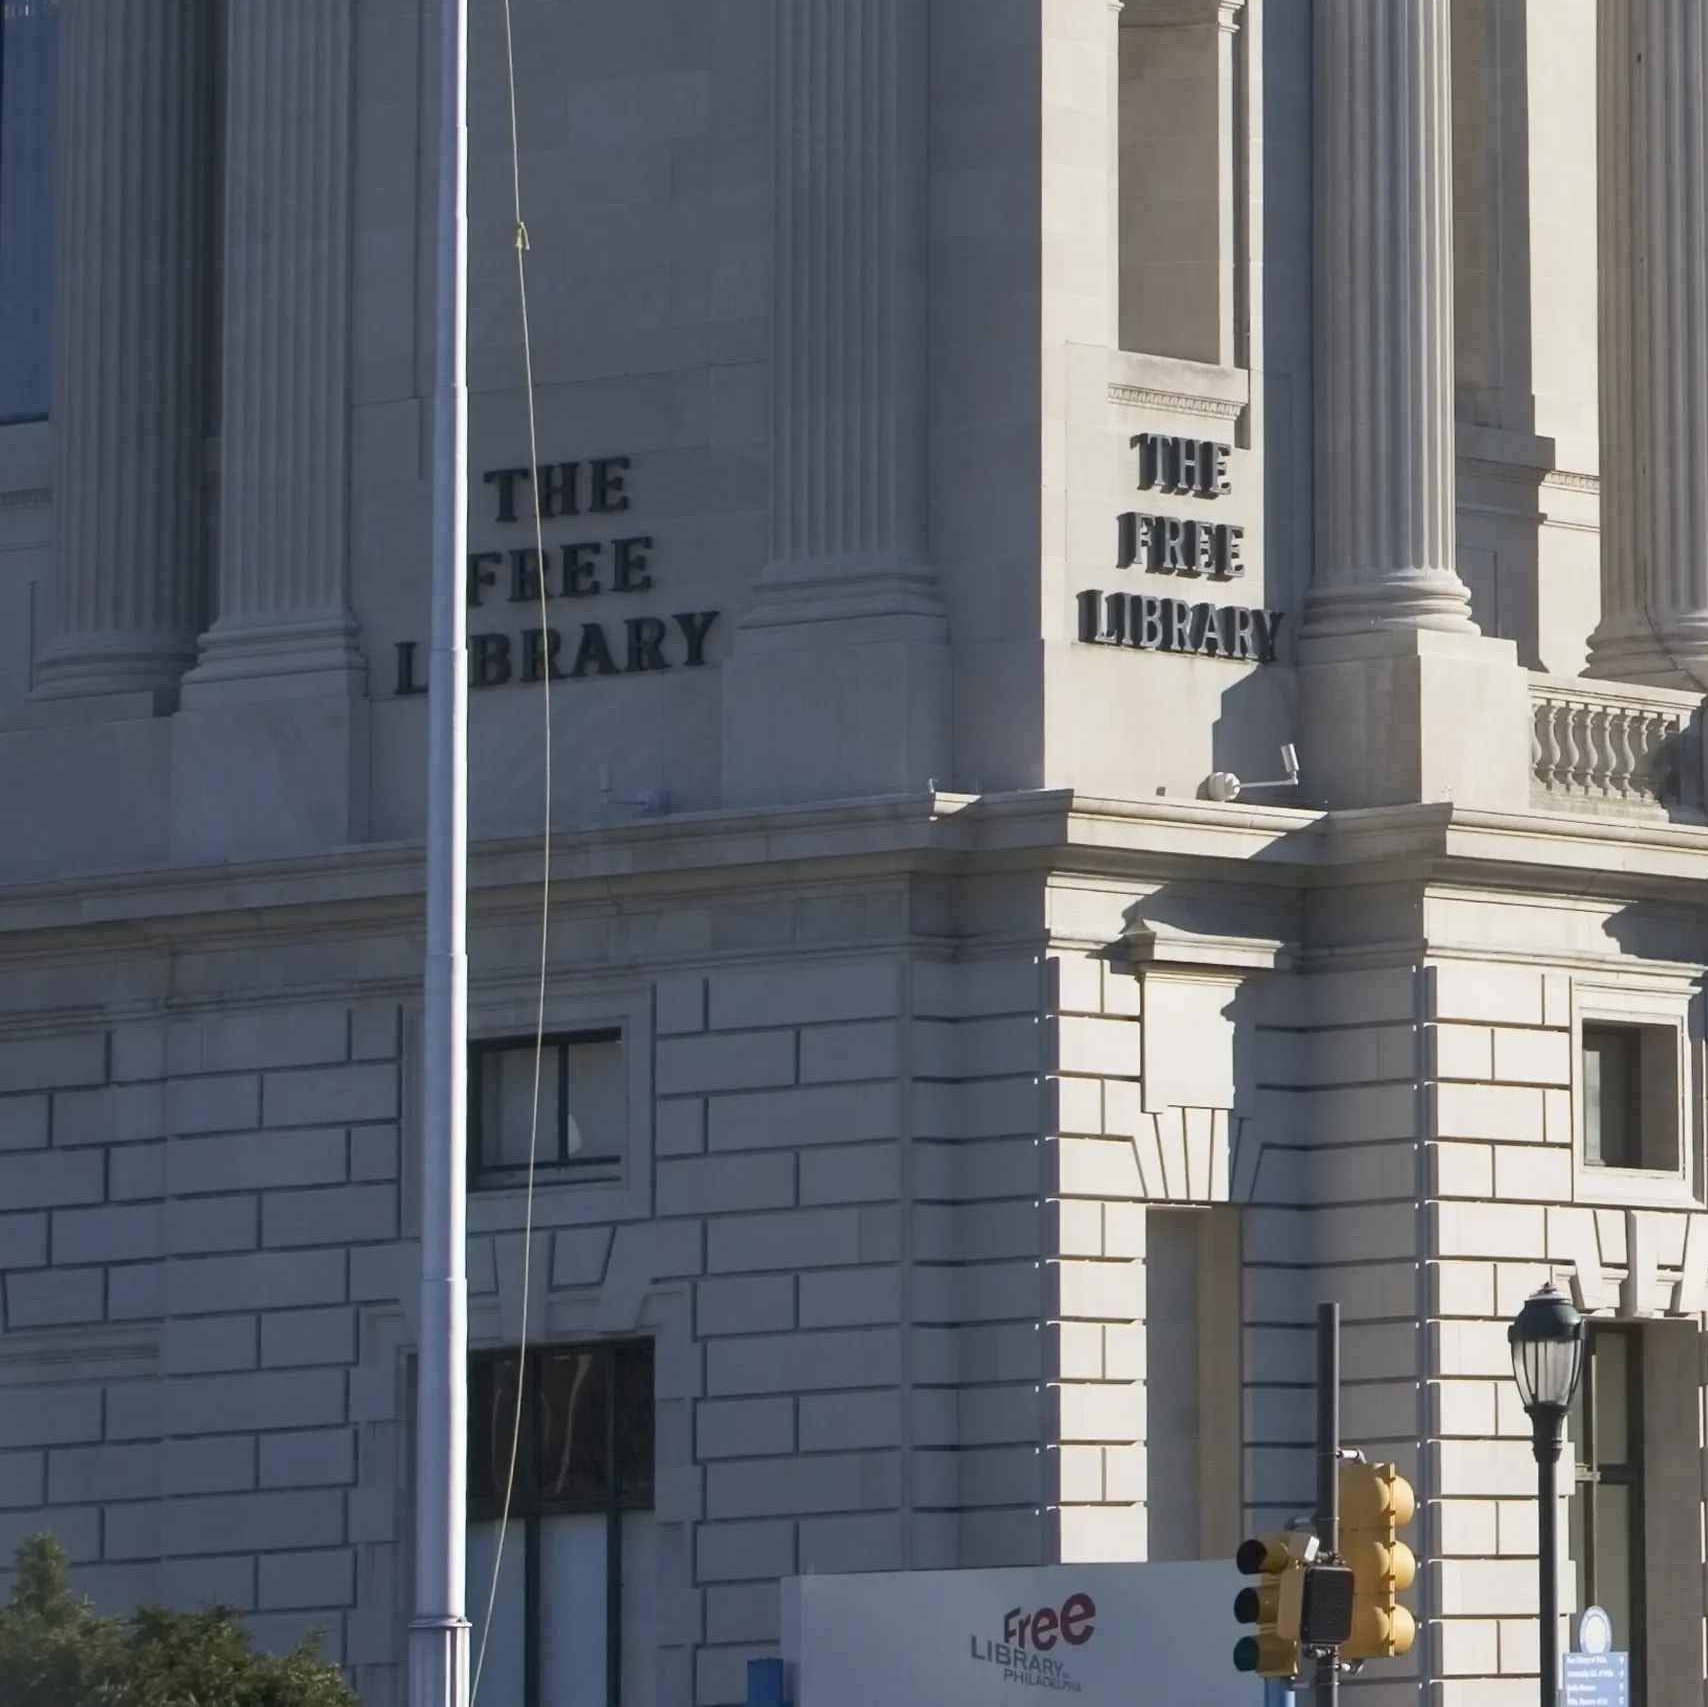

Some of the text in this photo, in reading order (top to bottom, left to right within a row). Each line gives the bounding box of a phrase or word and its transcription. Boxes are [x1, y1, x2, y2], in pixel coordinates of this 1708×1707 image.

[482, 456, 631, 522] THE
[1134, 433, 1232, 496] THE
[467, 535, 653, 607] FREE
[1121, 511, 1245, 579] FREE
[393, 610, 719, 696] LBRARY
[1080, 589, 1284, 662] LIBRARY
[1003, 1592, 1096, 1652] Free
[970, 1634, 1064, 1678] LIBRARY
[1003, 1667, 1083, 1693] PHILADELPHIA
